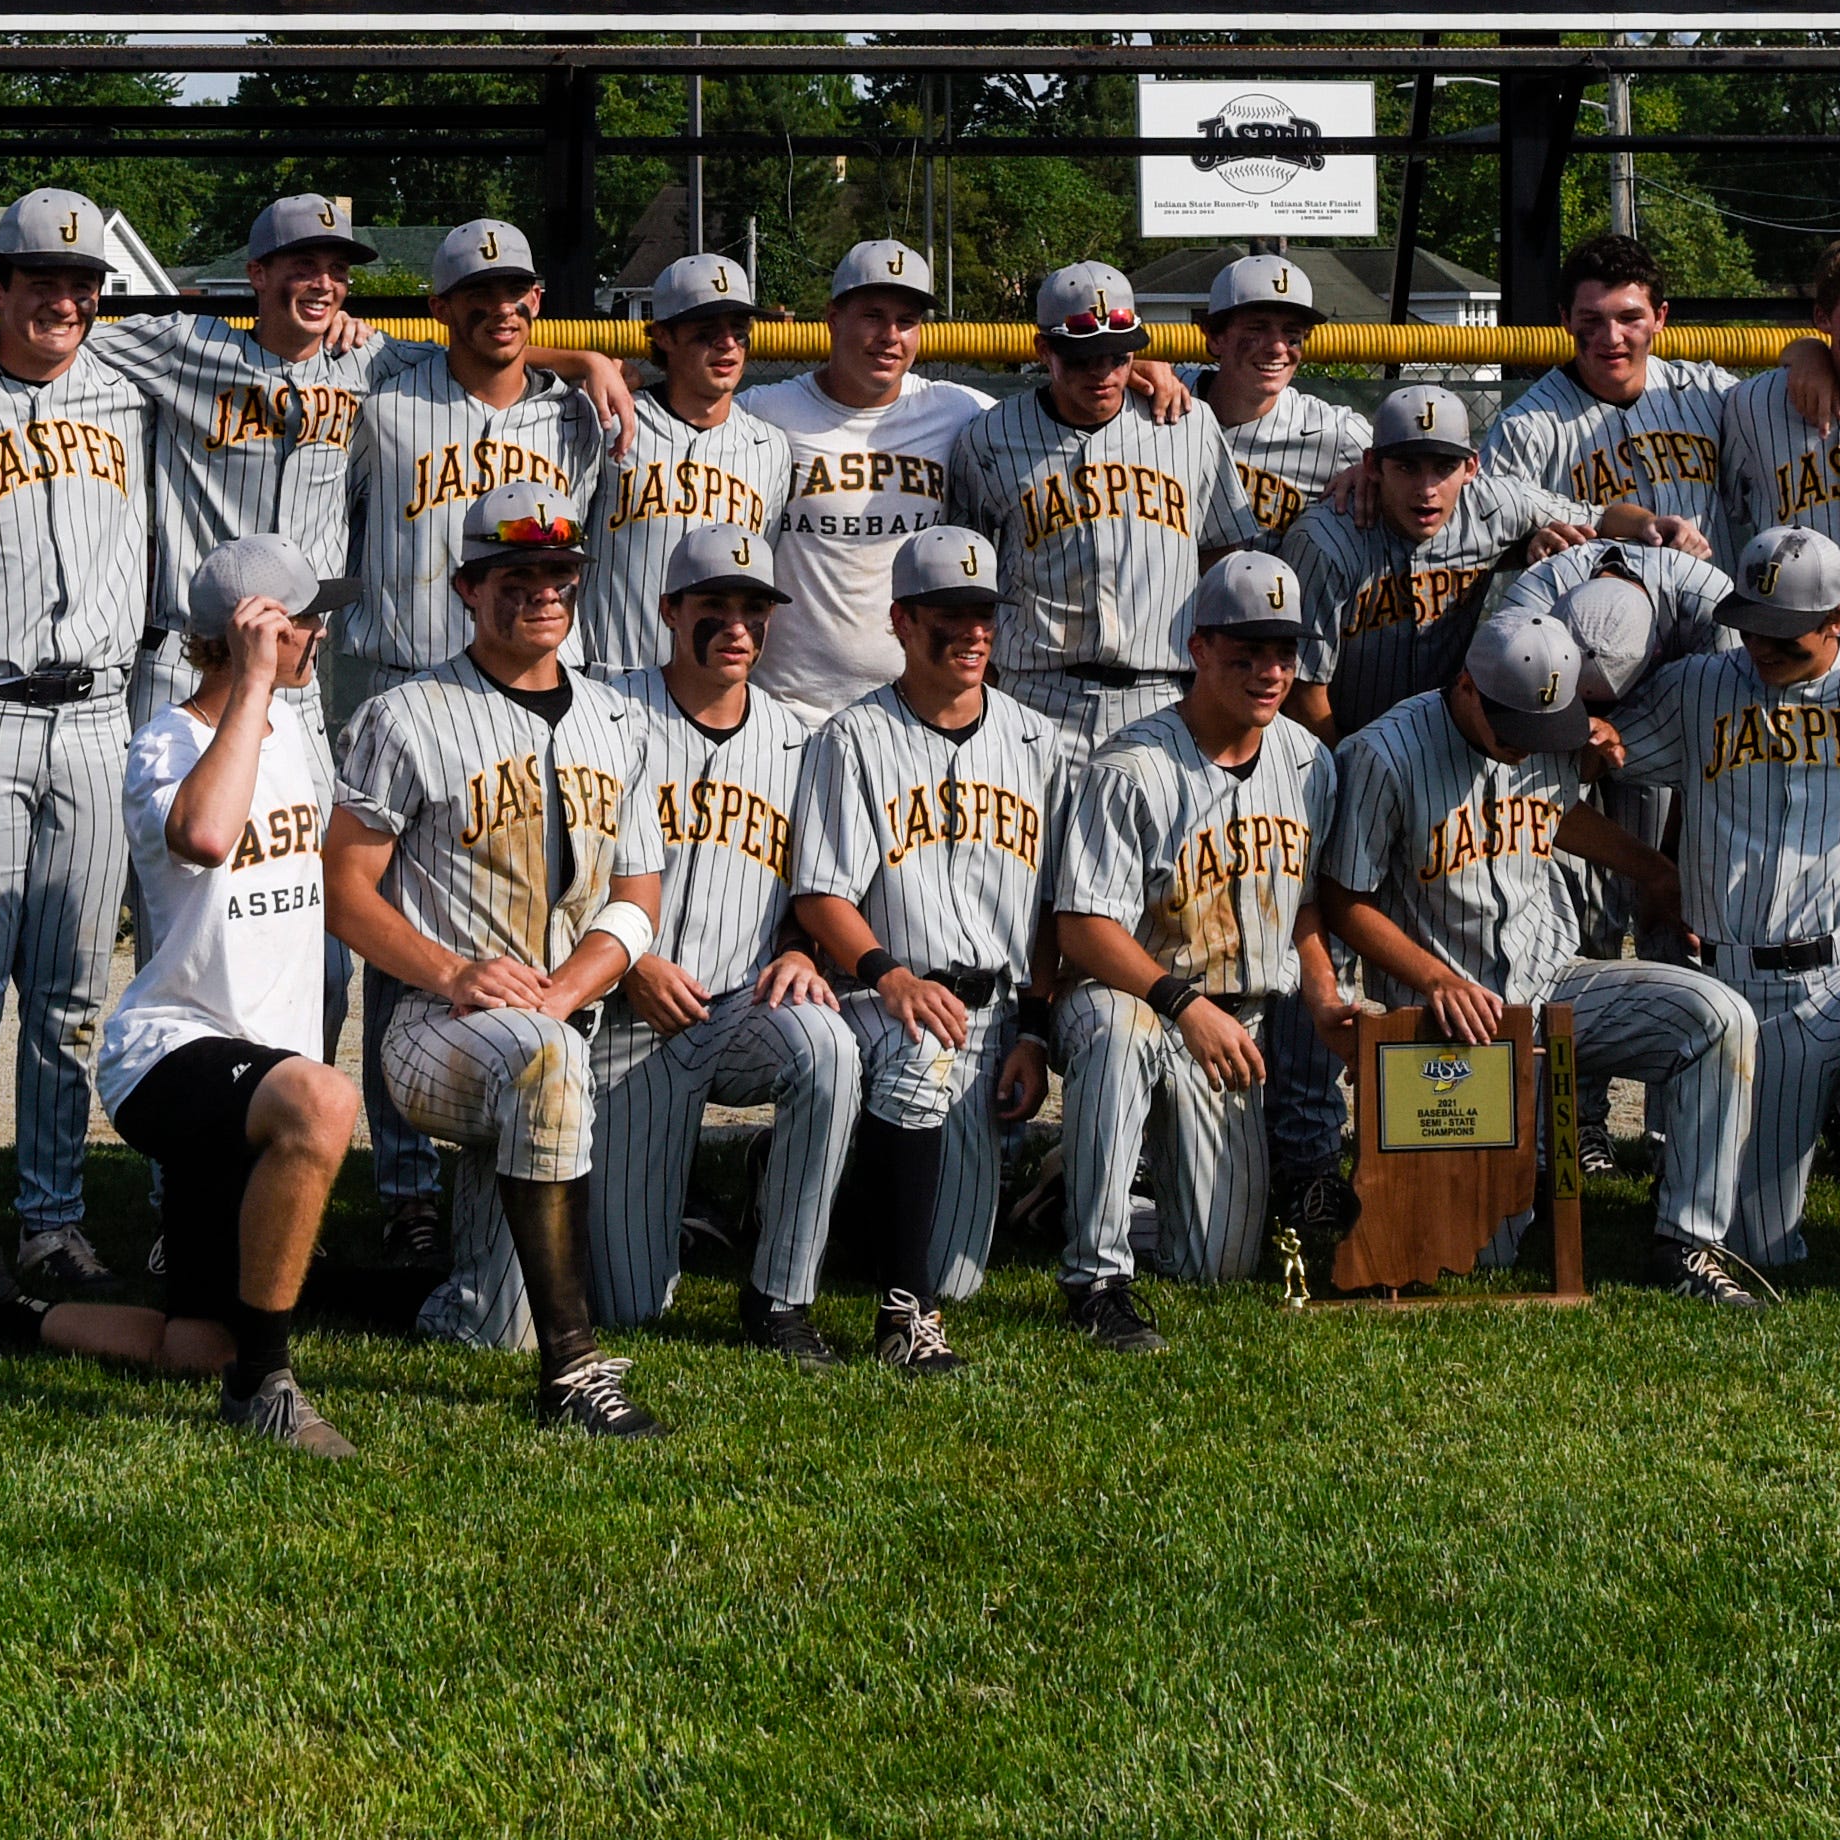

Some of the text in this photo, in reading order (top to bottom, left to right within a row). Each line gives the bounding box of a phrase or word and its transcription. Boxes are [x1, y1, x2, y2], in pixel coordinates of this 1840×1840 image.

[317, 203, 336, 229] J
[1214, 200, 1260, 209] Runner-Up
[1270, 200, 1362, 208] Indiana State Finalist
[61, 210, 78, 245] J
[479, 231, 500, 261] J
[712, 265, 729, 294] J
[887, 250, 904, 277] J
[1272, 267, 1289, 296] J
[1090, 289, 1109, 321] J
[1416, 400, 1436, 433] J
[1572, 431, 1718, 505] JASPER
[609, 460, 763, 537] JASPER
[1021, 462, 1191, 551] JASPER
[732, 537, 750, 567] J
[961, 544, 978, 578] J
[1267, 576, 1284, 611] J
[1757, 562, 1781, 597] J
[1342, 567, 1491, 640] JASPE
[1538, 672, 1560, 706] J
[461, 753, 624, 847] JASPE
[231, 804, 323, 871] ASP
[658, 779, 793, 887] ASPER
[885, 779, 1041, 871] JASPER
[1418, 794, 1562, 884] JASPE
[228, 887, 321, 920] ASEBA
[1422, 1059, 1472, 1082] IHSAA
[1417, 1108, 1478, 1118] BASEBALL 4A
[1438, 1099, 1457, 1107] 2021
[1420, 1119, 1442, 1127] SEMI
[1448, 1118, 1476, 1127] STATE
[1421, 1127, 1475, 1137] CHAMPIONS
